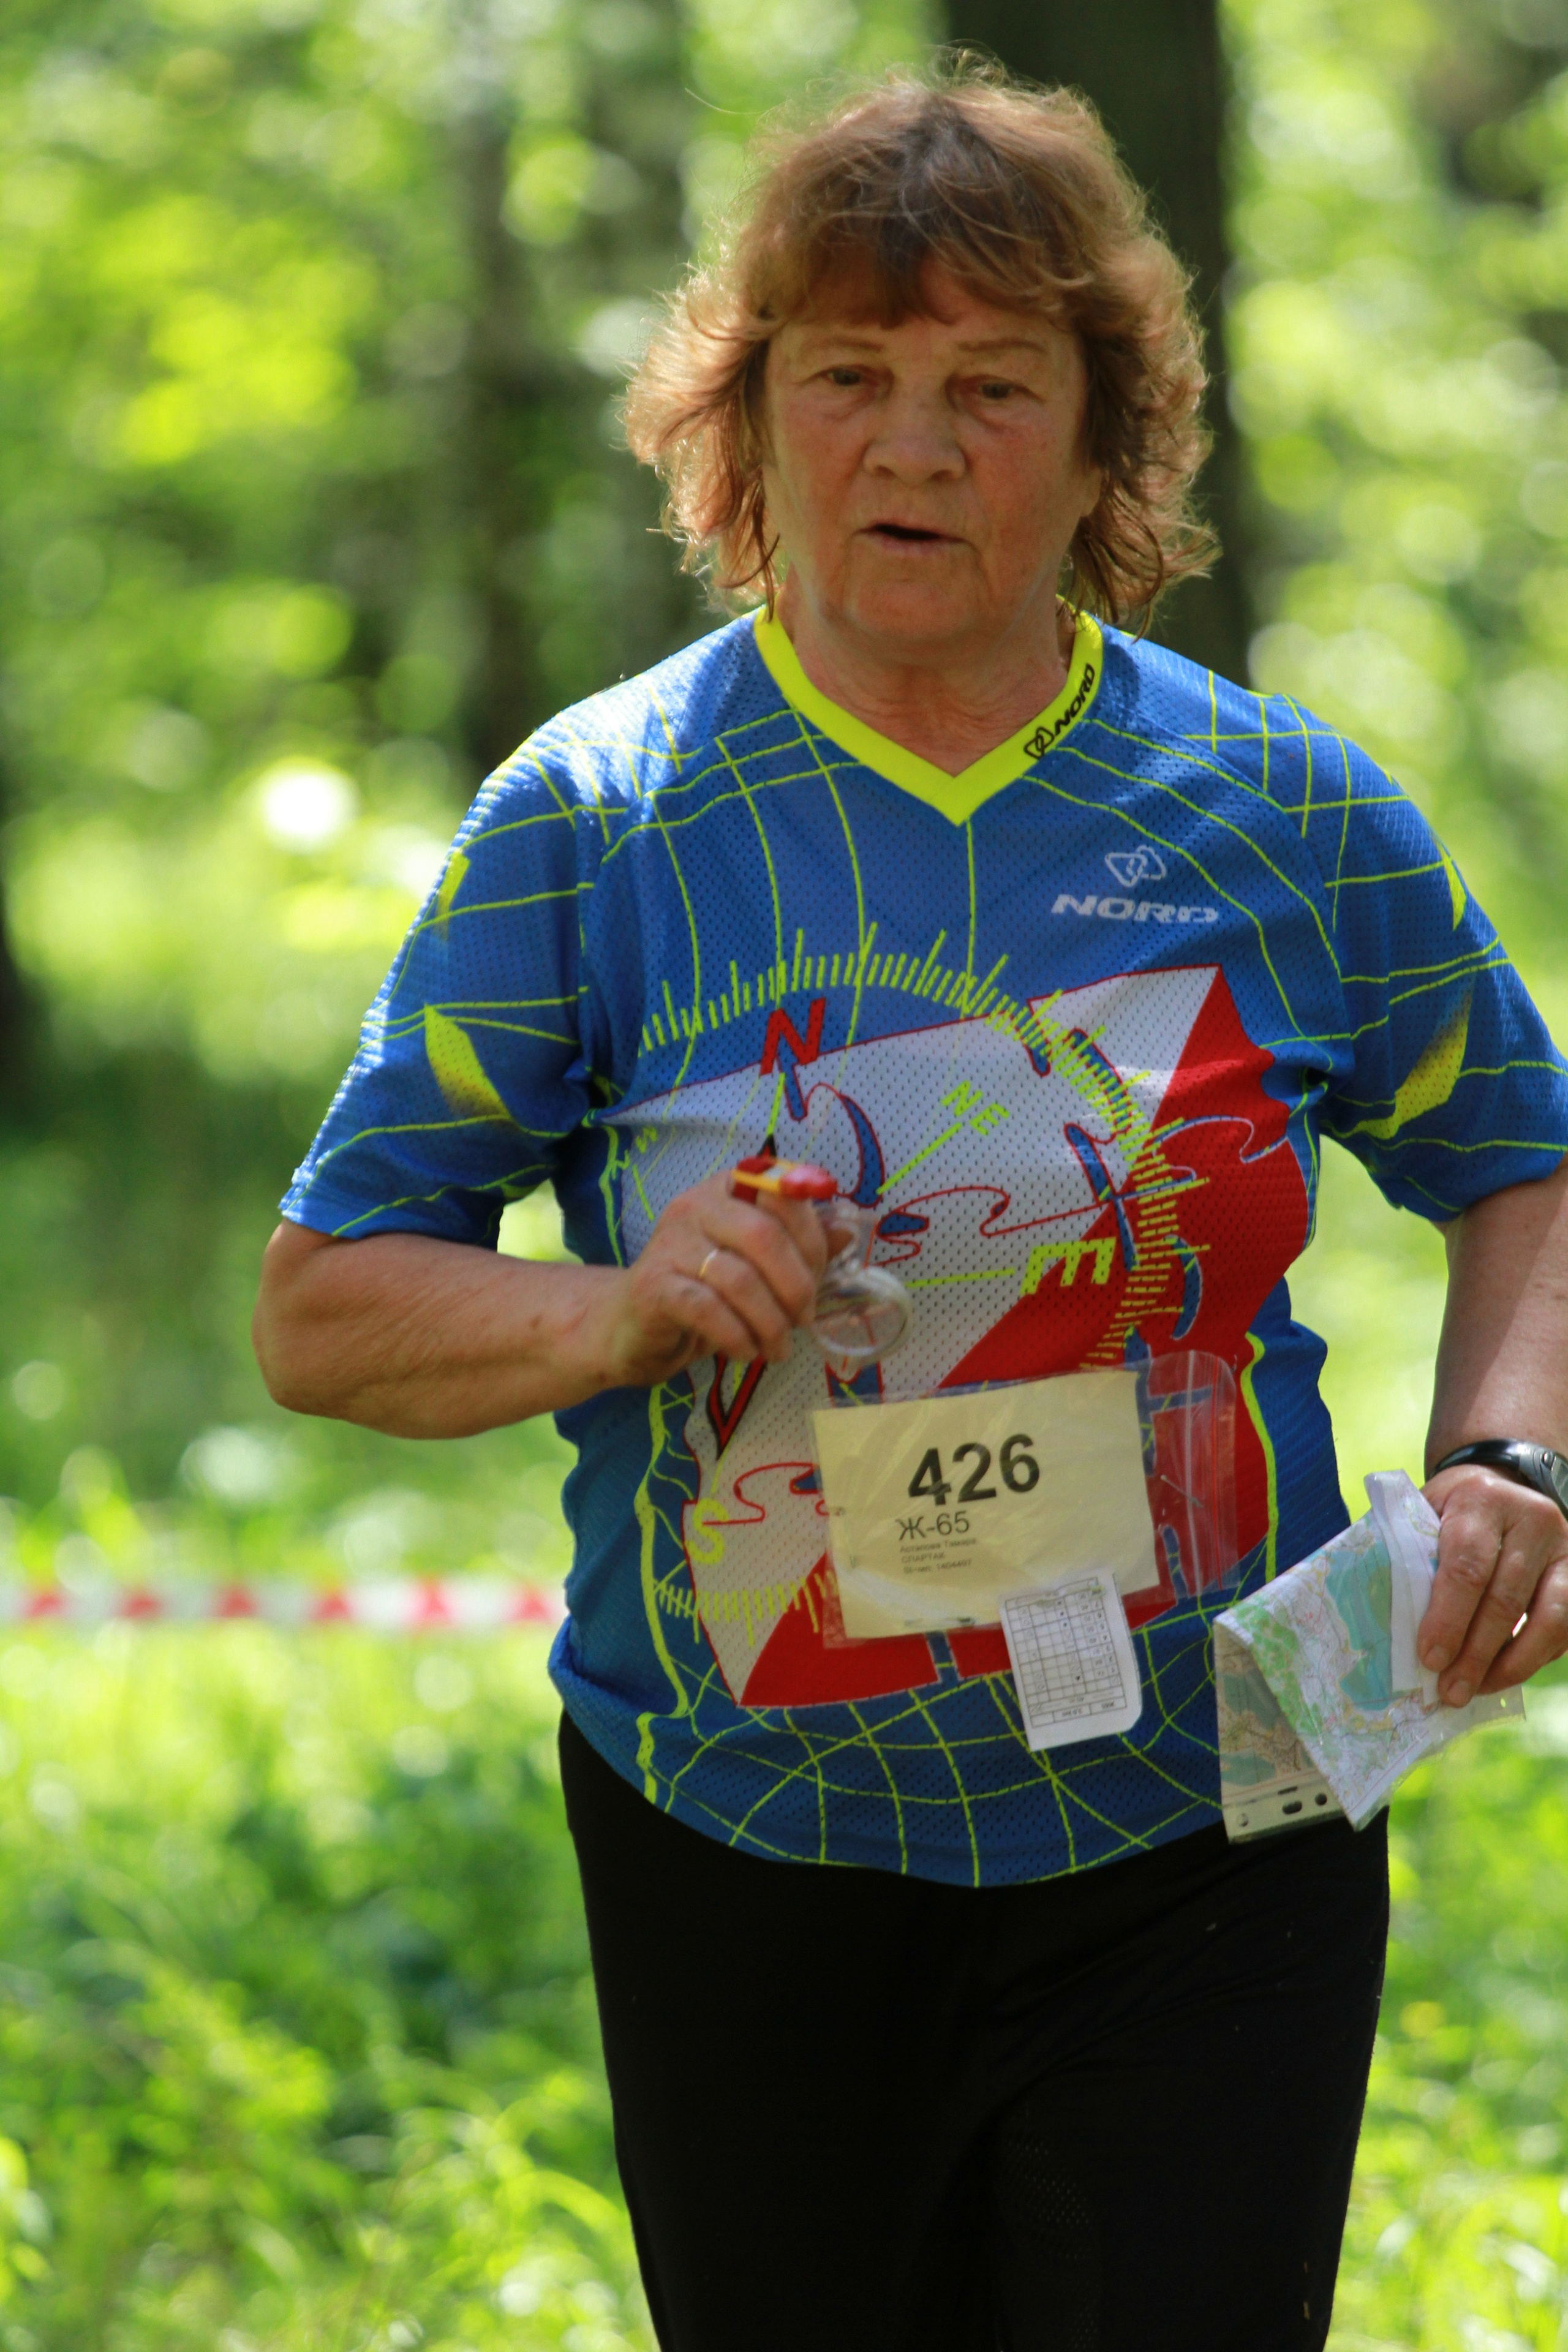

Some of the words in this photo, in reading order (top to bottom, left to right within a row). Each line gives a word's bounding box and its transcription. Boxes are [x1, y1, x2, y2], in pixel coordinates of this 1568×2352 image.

[1054, 663, 1095, 737] NORD
[1051, 894, 1219, 923] NORD
[760, 997, 826, 1076] N
[1020, 1238, 1117, 1294] E
[908, 1434, 1039, 1506] 426
[687, 1498, 729, 1564] S
[895, 1510, 970, 1540] Ж-65
